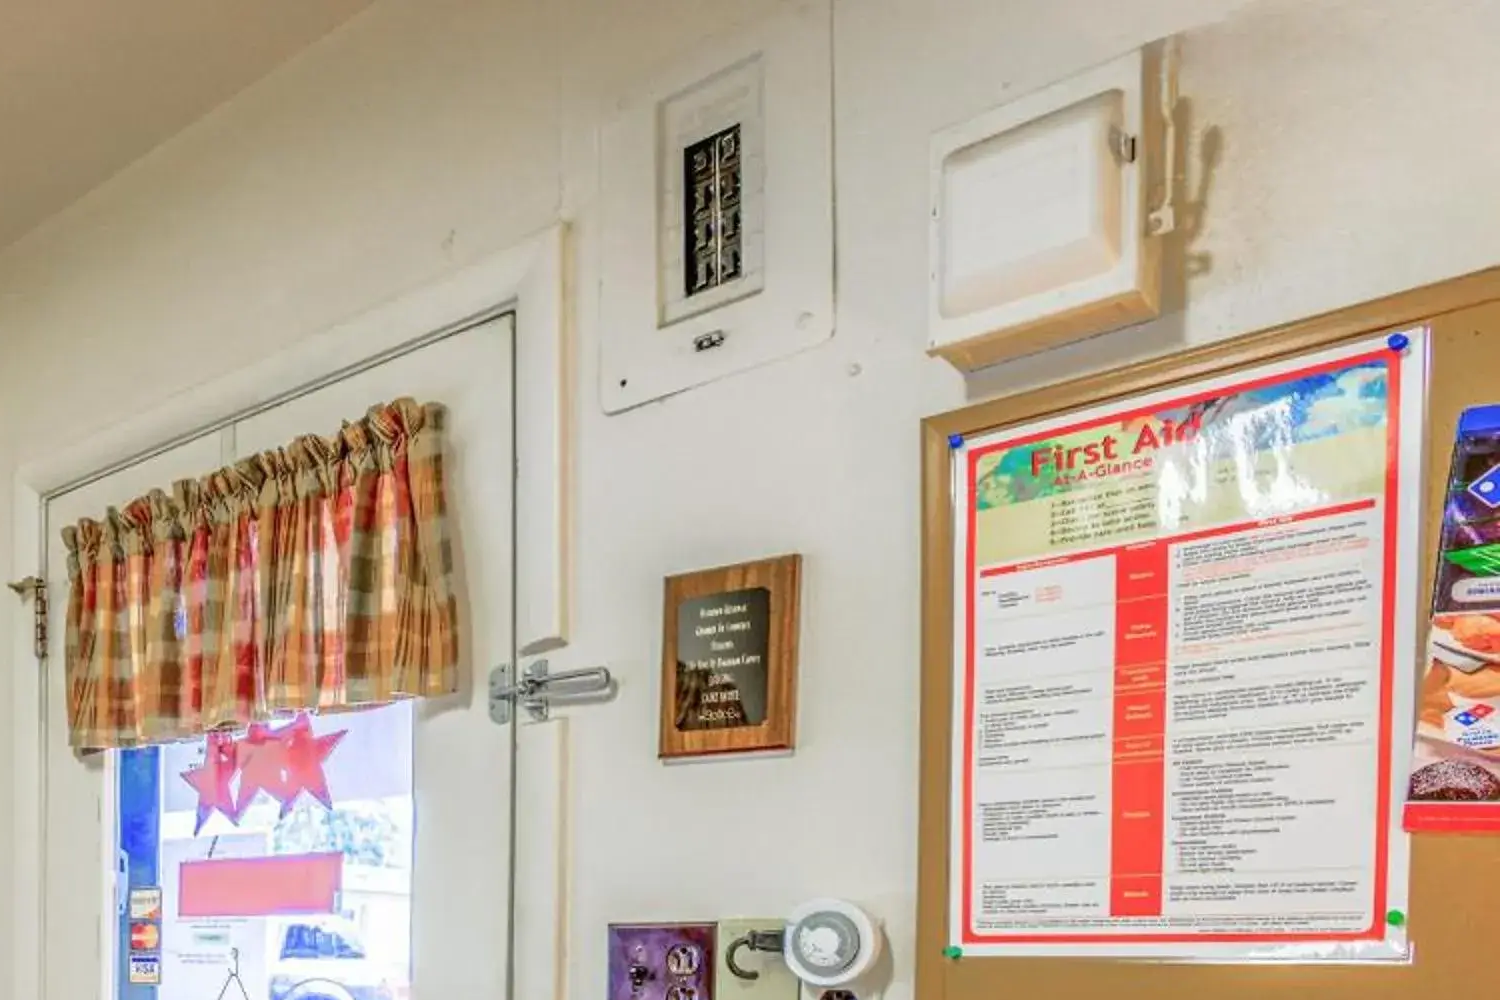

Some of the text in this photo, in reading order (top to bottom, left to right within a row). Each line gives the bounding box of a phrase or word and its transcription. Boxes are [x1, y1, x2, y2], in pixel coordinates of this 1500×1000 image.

[1030, 411, 1203, 477] First Aid
[1053, 457, 1153, 486] At-A-Glance
